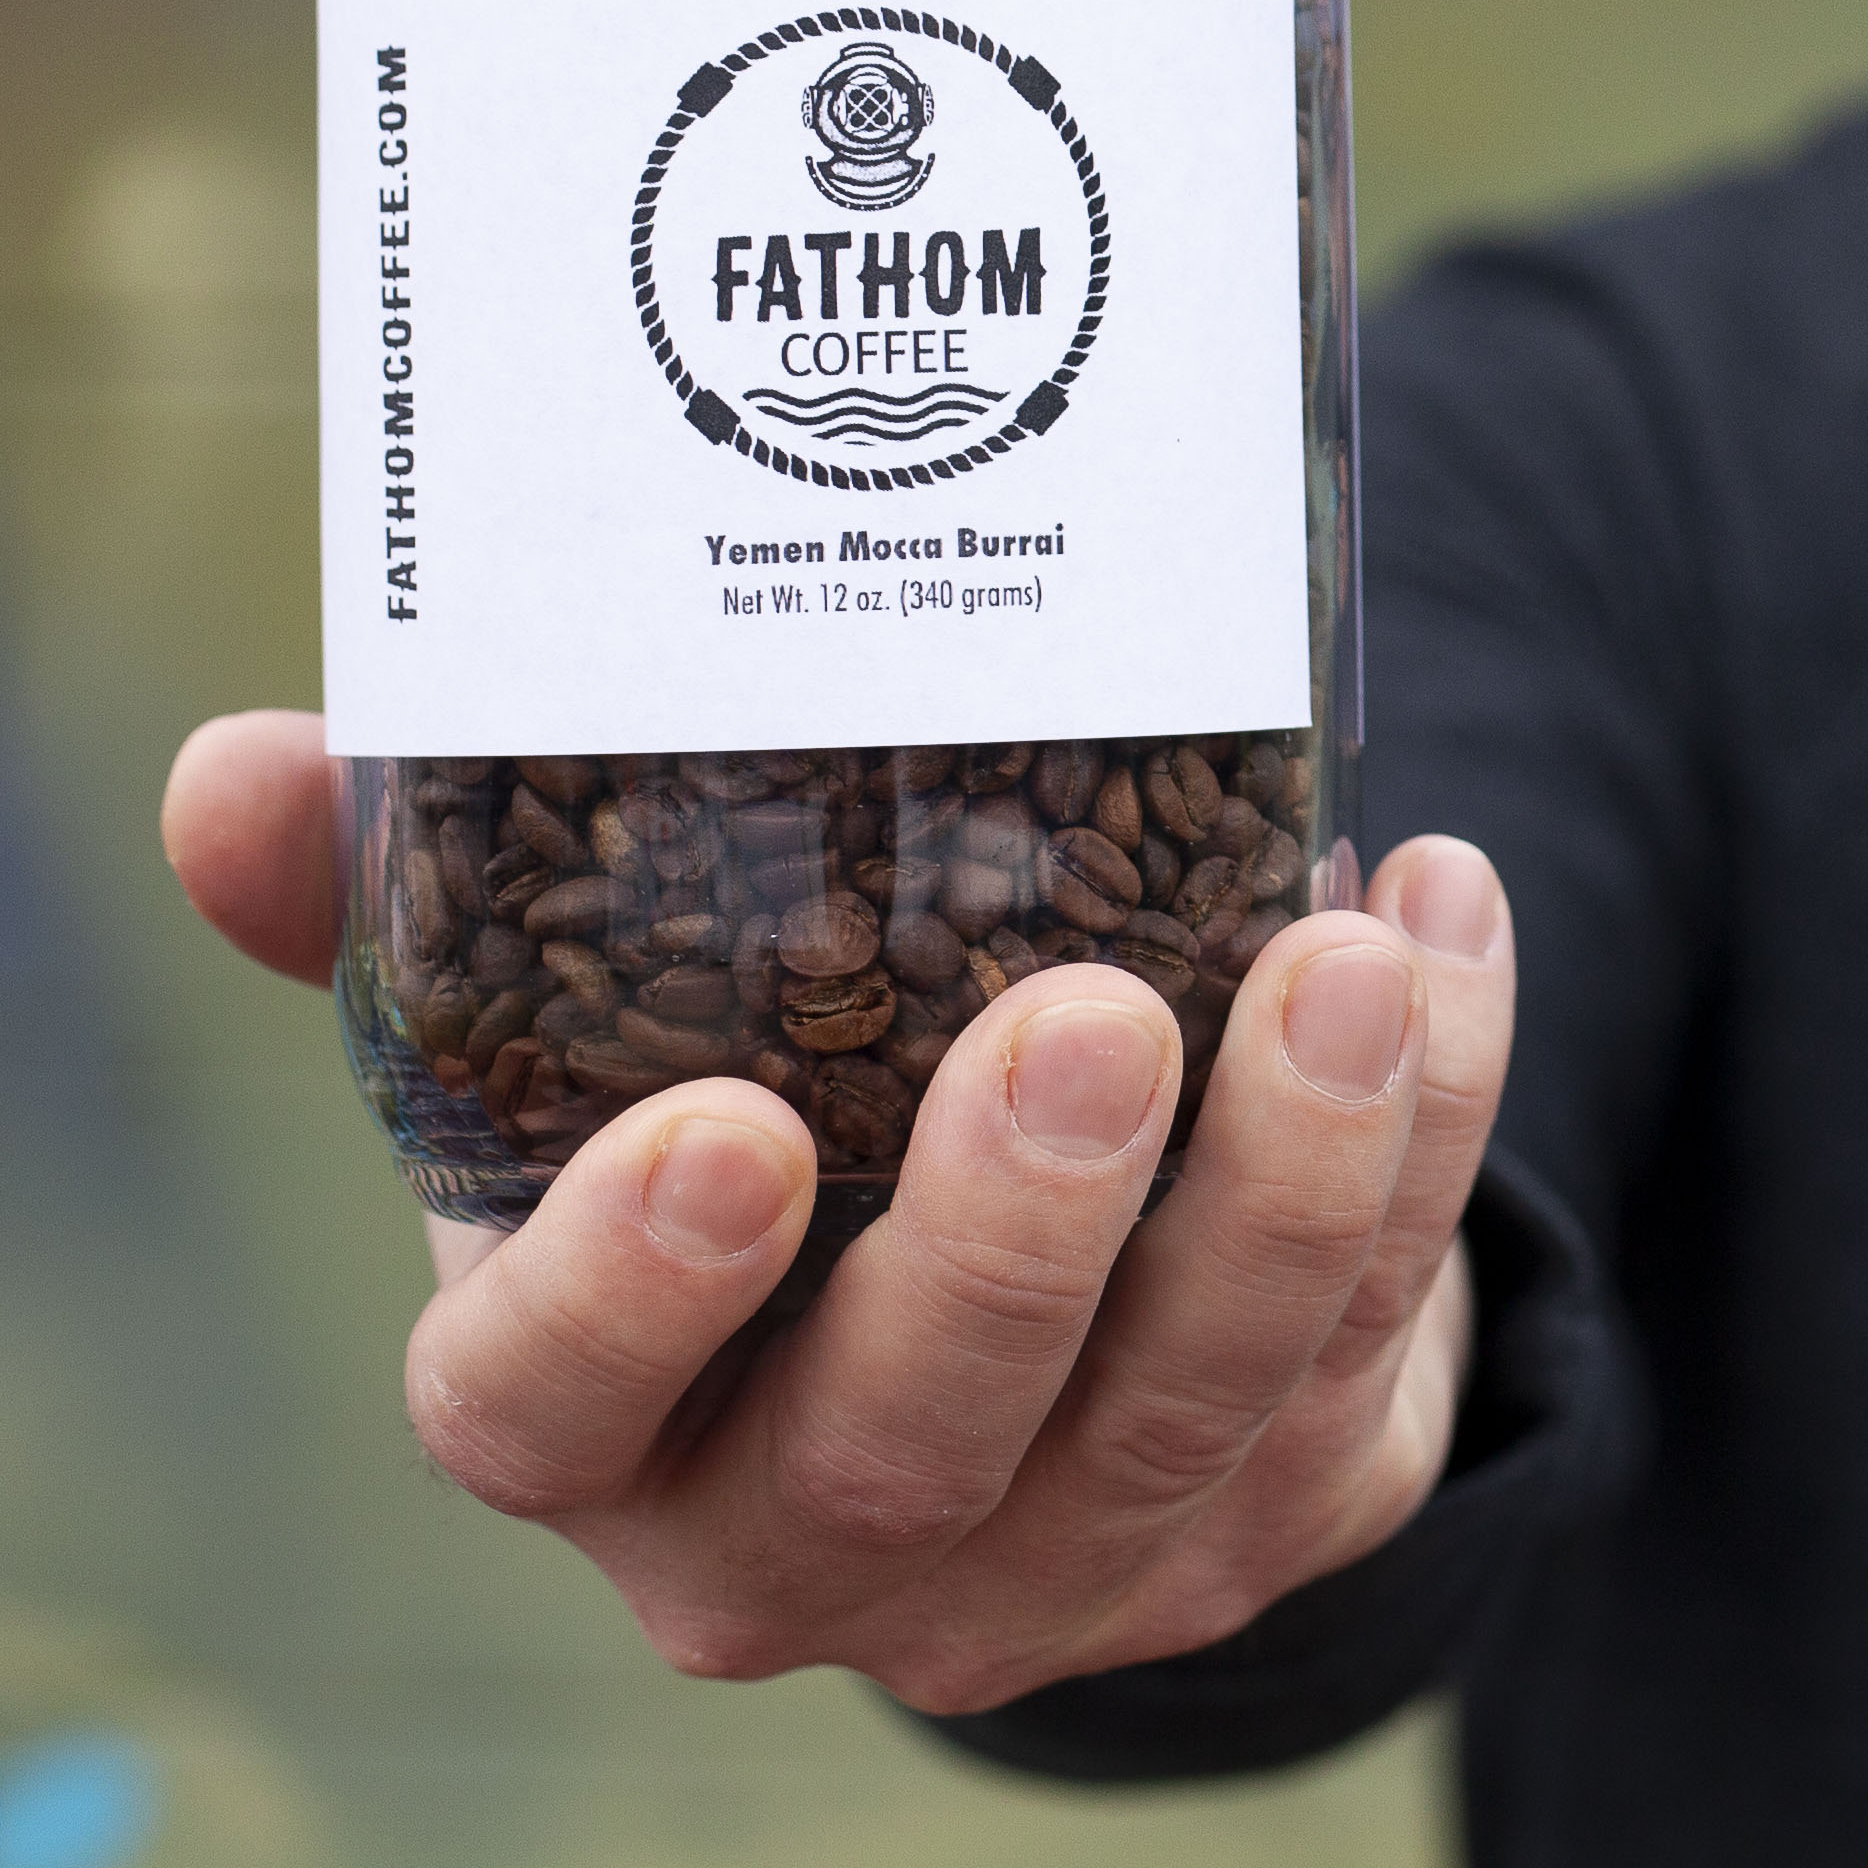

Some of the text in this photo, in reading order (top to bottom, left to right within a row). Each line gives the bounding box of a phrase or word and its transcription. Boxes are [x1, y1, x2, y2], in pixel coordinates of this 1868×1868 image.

[710, 226, 1048, 323] FATHOM
[376, 45, 418, 623] FATHOMCOFFEE.COM
[781, 329, 969, 377] COFFEE
[703, 522, 1064, 566] Yemen Mocca Burrai
[723, 575, 1042, 618] Net Wt. 12 oz. (340 grams)
